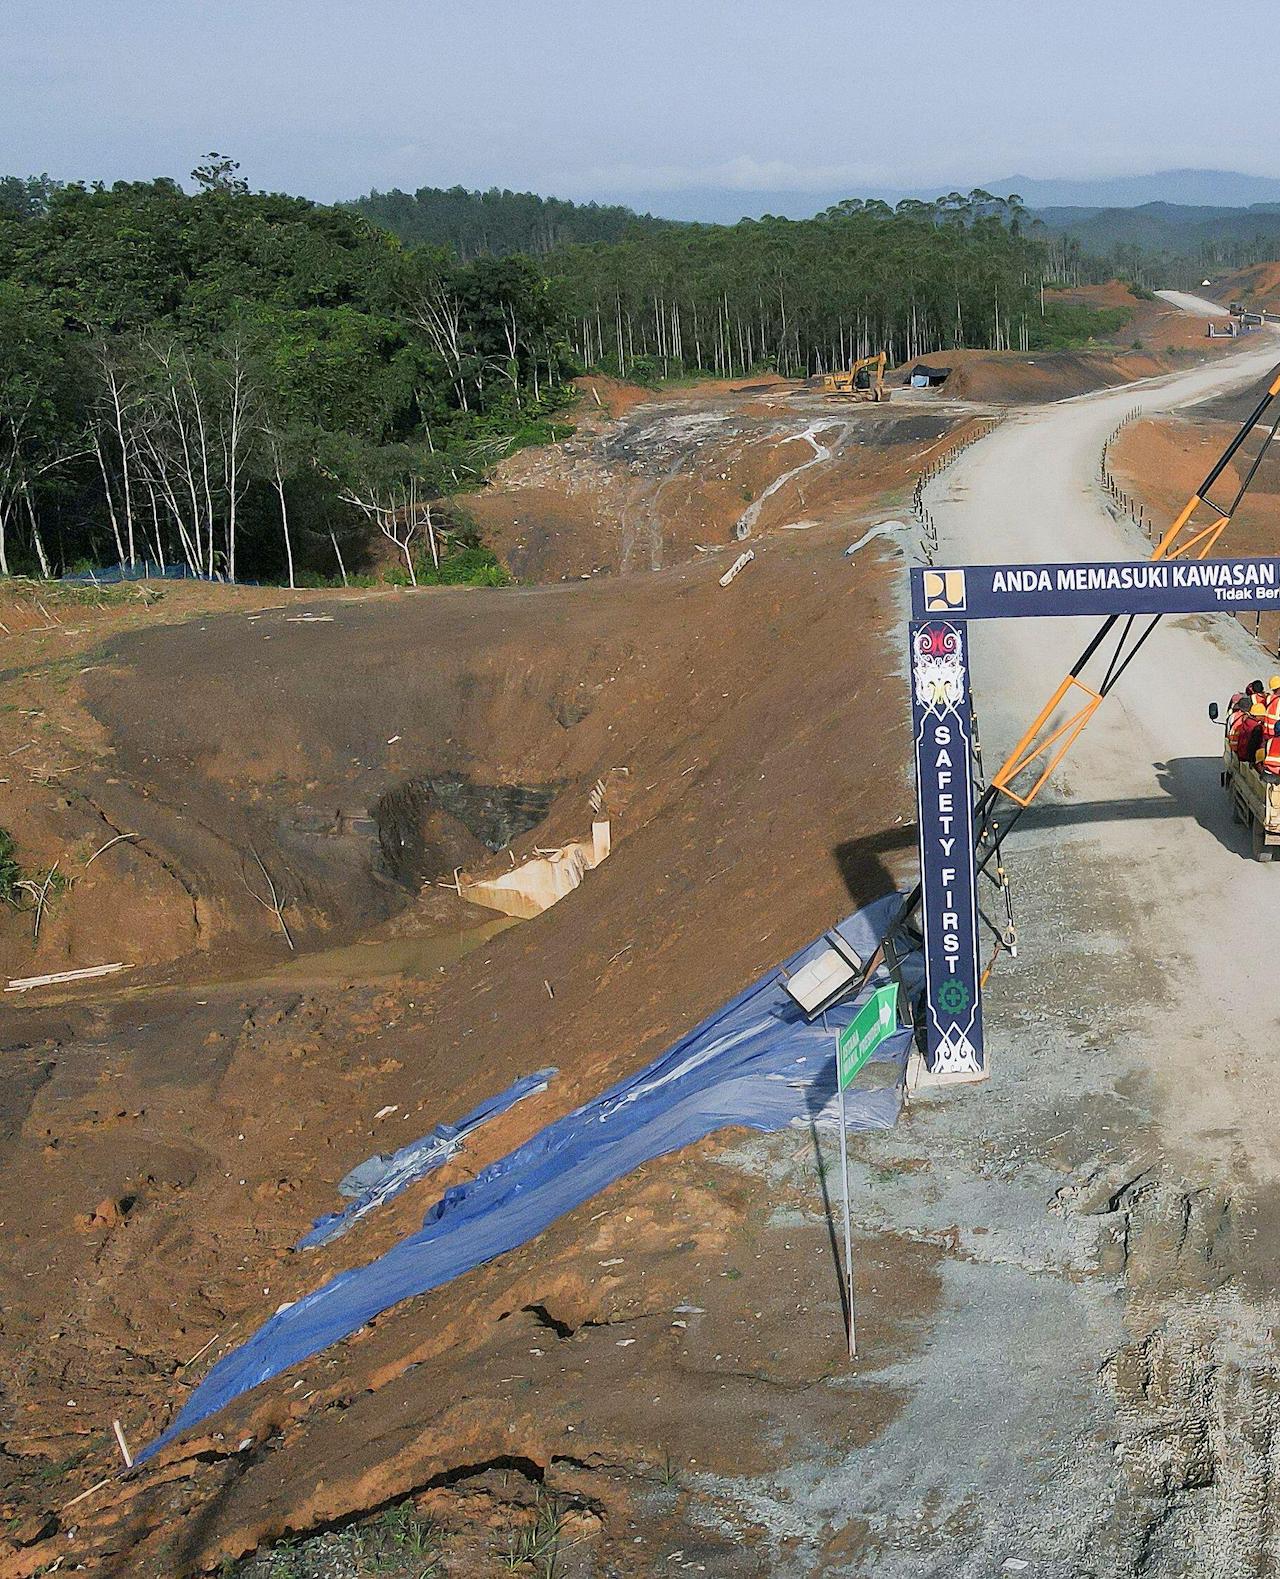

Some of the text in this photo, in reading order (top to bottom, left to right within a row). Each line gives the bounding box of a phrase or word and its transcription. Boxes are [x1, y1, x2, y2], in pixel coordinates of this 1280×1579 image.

[992, 569, 1052, 592] ANDA
[1057, 567, 1168, 591] MEMASUKI
[1173, 563, 1274, 587] KAWASAN
[1214, 586, 1252, 600] Tidak
[934, 726, 959, 974] SAFETY FIRST
